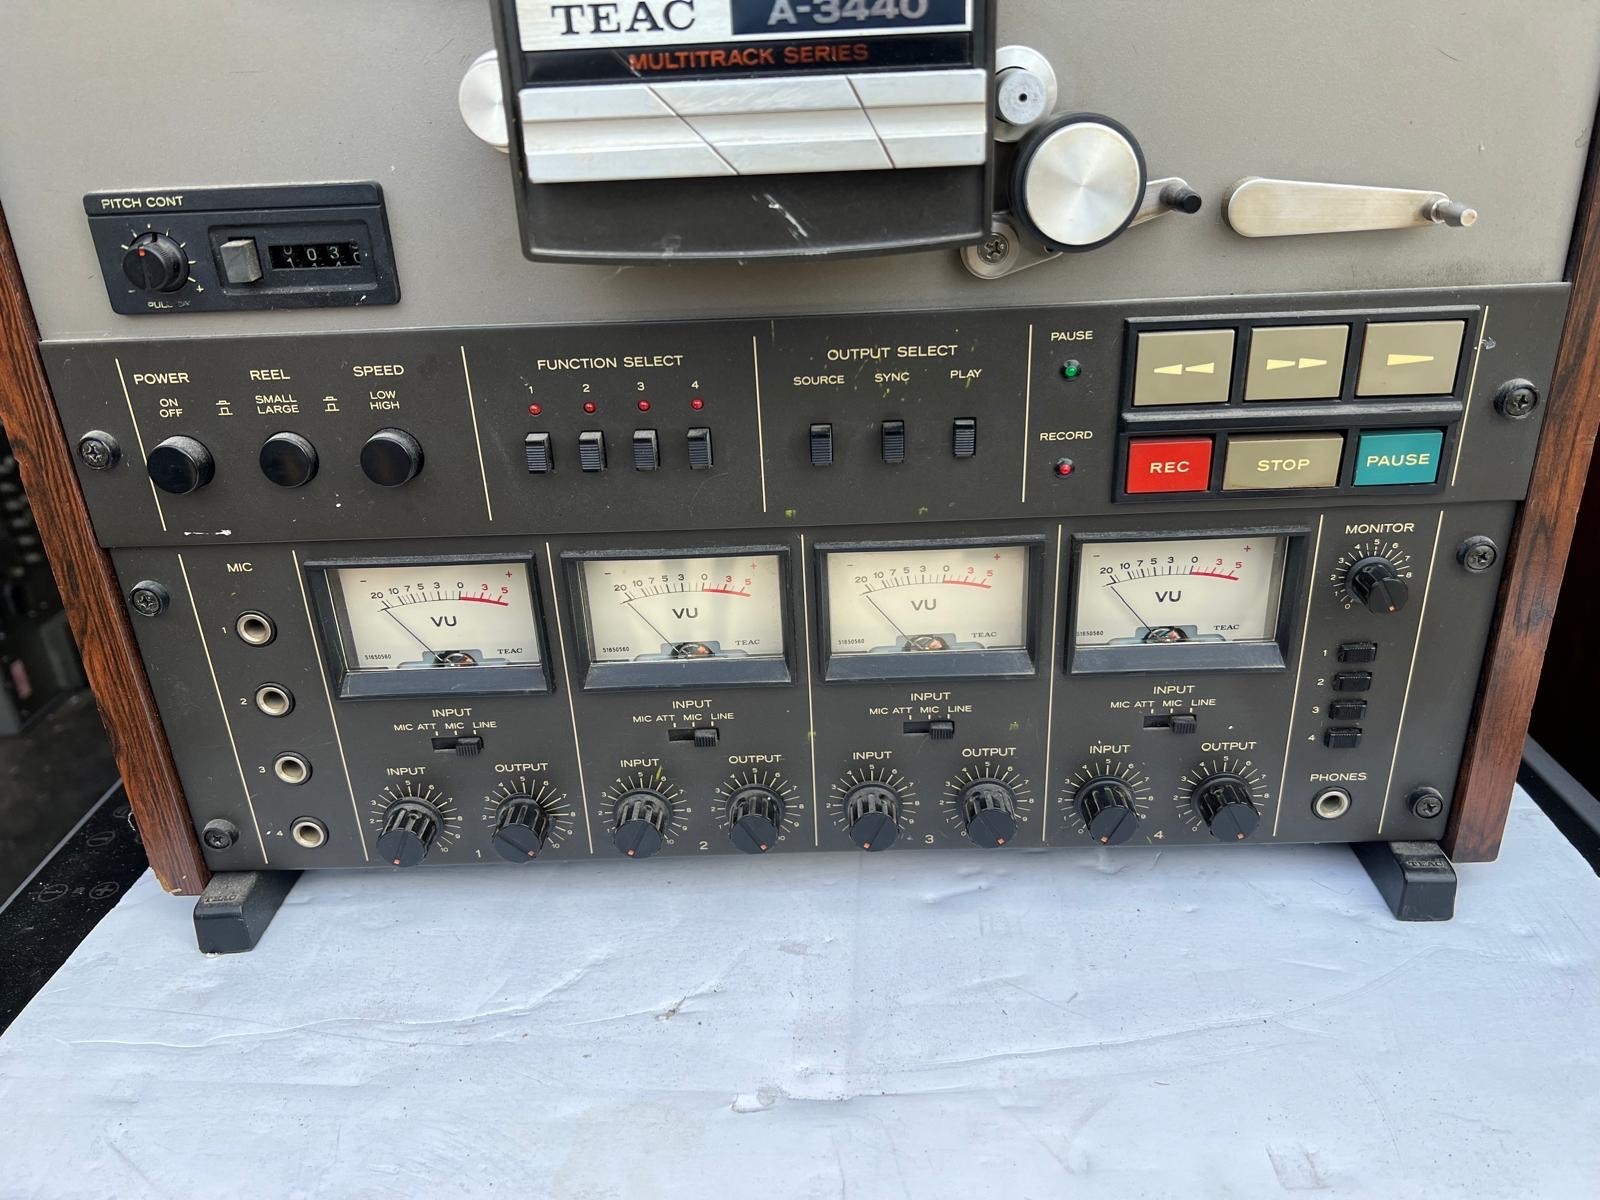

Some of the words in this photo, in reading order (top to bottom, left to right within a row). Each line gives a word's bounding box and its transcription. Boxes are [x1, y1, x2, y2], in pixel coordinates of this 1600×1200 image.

[551, 0, 696, 35] TEAC
[628, 47, 774, 72] MULTITRACK
[784, 43, 869, 65] SERIES
[101, 198, 142, 209] PITCH
[146, 196, 184, 207] CONT
[1051, 330, 1093, 342] PAUSE
[827, 347, 891, 361] OUTPUT
[898, 344, 957, 358] SELECT
[538, 357, 617, 371] FUNCTION
[623, 355, 683, 368] SELECT
[250, 369, 290, 381] REEL
[353, 365, 404, 377] SPEED
[950, 368, 982, 379] PLAY
[134, 372, 190, 384] POWER
[793, 374, 845, 386] SOURCE
[875, 372, 910, 383] SYNC
[582, 384, 590, 392] 2
[637, 382, 645, 391] 3
[691, 380, 699, 389] 4
[370, 390, 396, 400] LOW
[528, 386, 534, 394] 1
[160, 398, 178, 407] ON
[255, 394, 297, 404] SMALL
[257, 404, 300, 414] LARGE
[370, 401, 400, 410] HIGH
[160, 408, 183, 418] OFF
[1040, 431, 1093, 441] RECORD
[1366, 453, 1430, 467] PAUSE
[1150, 461, 1190, 474] REC
[1257, 459, 1310, 472] STOP
[1345, 523, 1415, 534] MONITOR
[227, 562, 253, 572] MIC
[1100, 566, 1114, 575] 20
[1155, 591, 1182, 602] VU
[911, 599, 937, 611] VU
[672, 608, 698, 619] VU
[430, 616, 457, 627] VU
[1153, 686, 1196, 694] INPUT
[910, 692, 951, 701] INPUT
[672, 700, 712, 709] INPUT
[432, 708, 472, 717] INPUT
[473, 721, 497, 729] LINE
[1089, 745, 1130, 754] INPUT
[1201, 742, 1256, 751] OUTPUT
[853, 751, 892, 760] INPUT
[962, 748, 1016, 757] OUTPUT
[620, 758, 660, 768] INPUT
[729, 755, 782, 764] OUTPUT
[387, 766, 426, 776] INPUT
[495, 762, 548, 772] OUTPUT
[1310, 772, 1367, 781] PHONES
[925, 835, 934, 844] 3
[699, 841, 708, 850] 2
